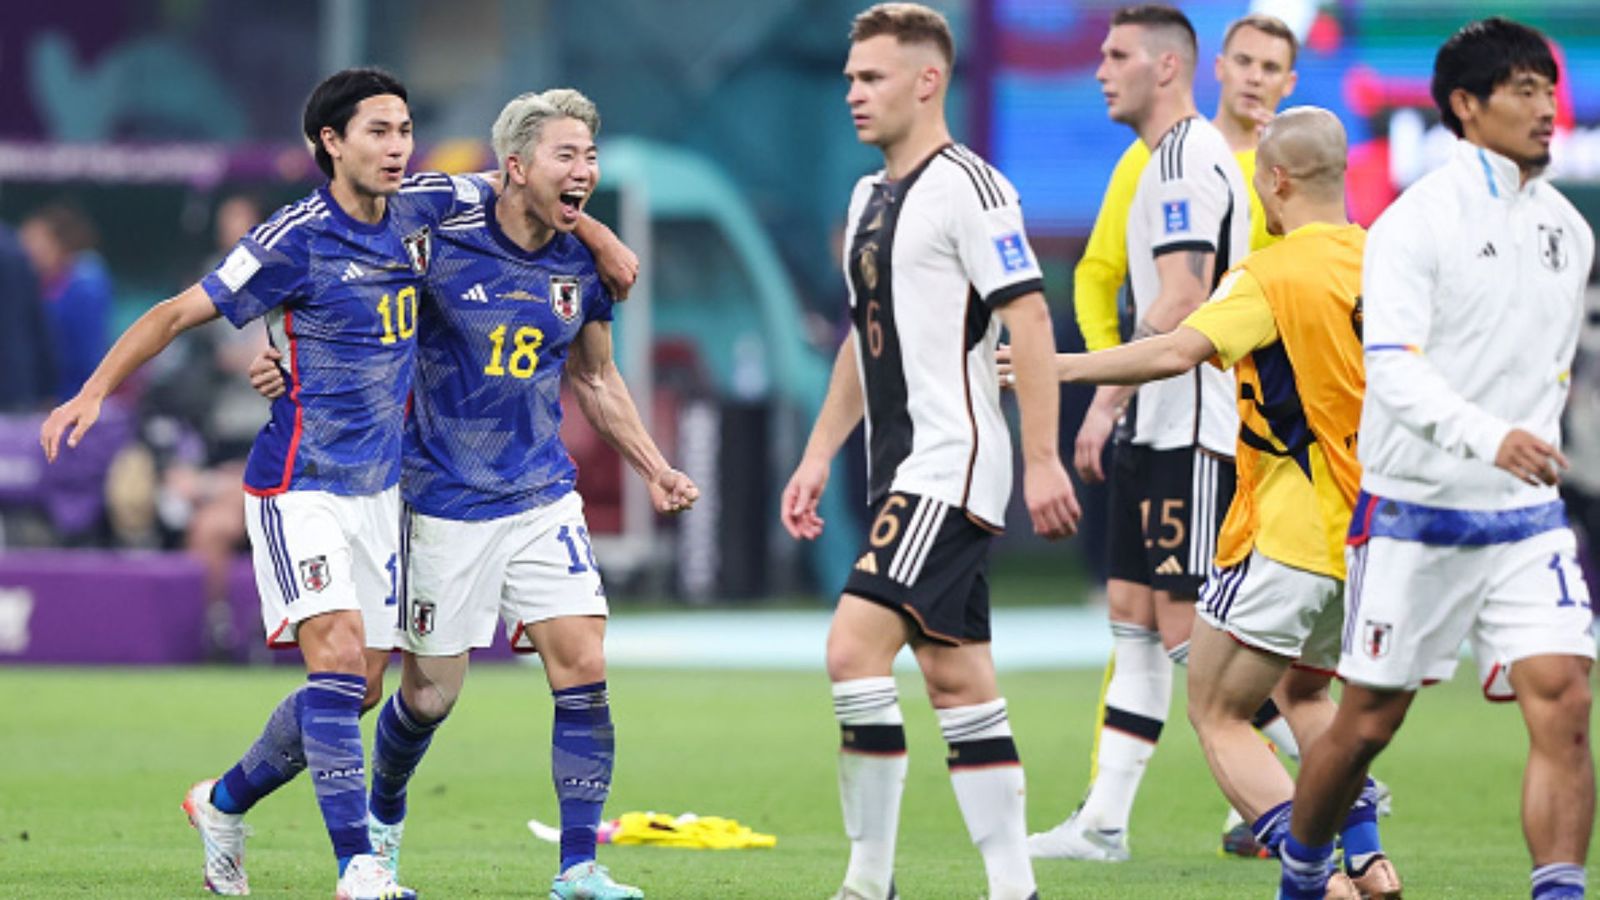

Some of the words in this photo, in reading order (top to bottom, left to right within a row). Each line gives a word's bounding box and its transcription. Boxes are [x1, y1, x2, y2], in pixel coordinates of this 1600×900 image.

[376, 286, 418, 345] 10
[865, 301, 884, 358] 6
[484, 324, 544, 378] 18
[869, 495, 909, 548] 6
[1139, 498, 1185, 549] 15
